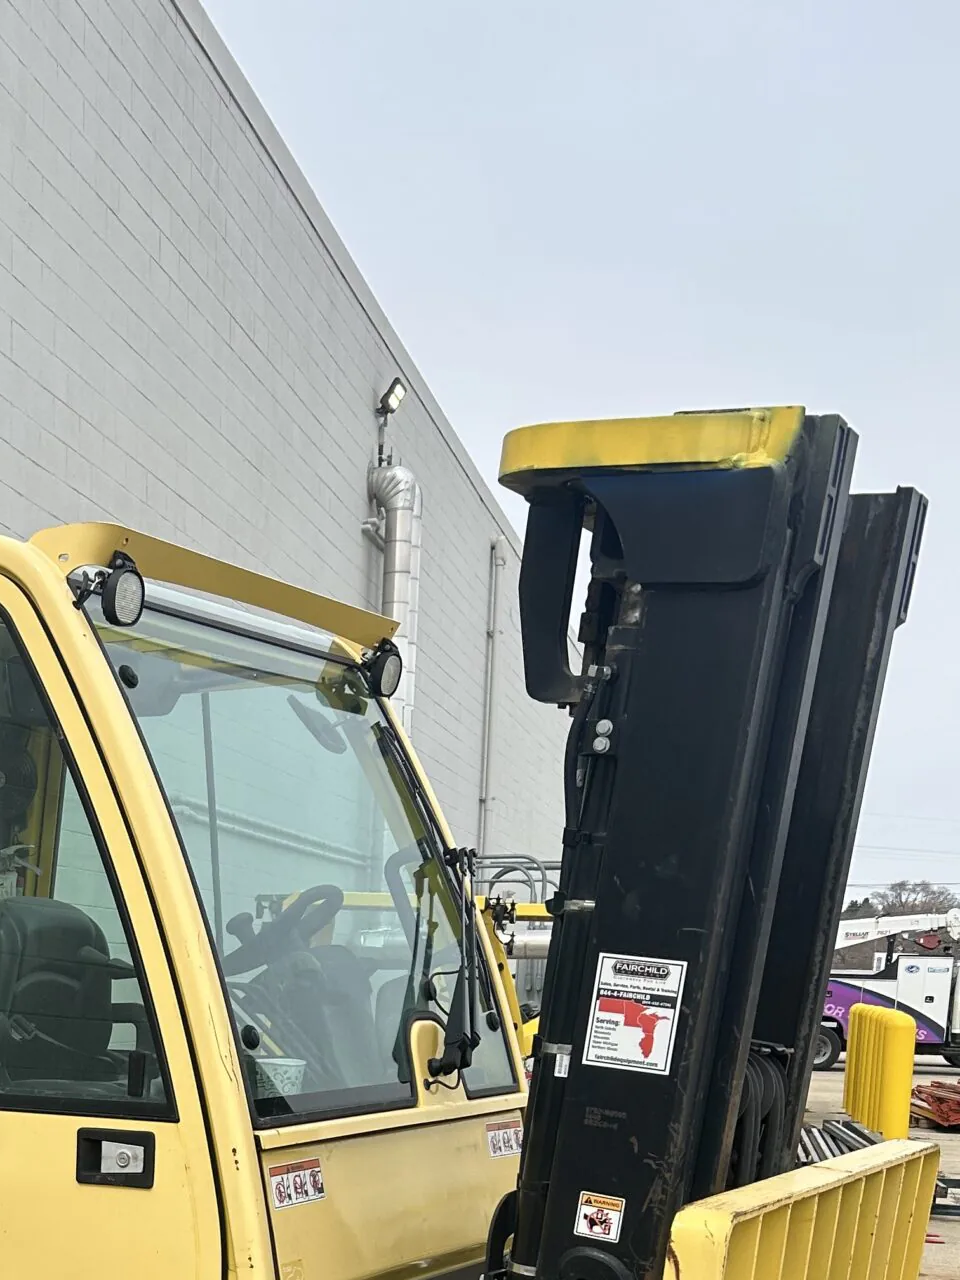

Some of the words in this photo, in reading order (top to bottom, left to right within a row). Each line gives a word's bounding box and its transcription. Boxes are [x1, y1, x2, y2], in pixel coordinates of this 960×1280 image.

[616, 963, 667, 974] FAIRCHILD
[600, 989, 650, 1000] 844-4-FAIRCHILD
[596, 1017, 620, 1026] Serving:
[594, 1054, 657, 1066] fairchildequipment.com
[593, 1198, 620, 1208] WARNING
